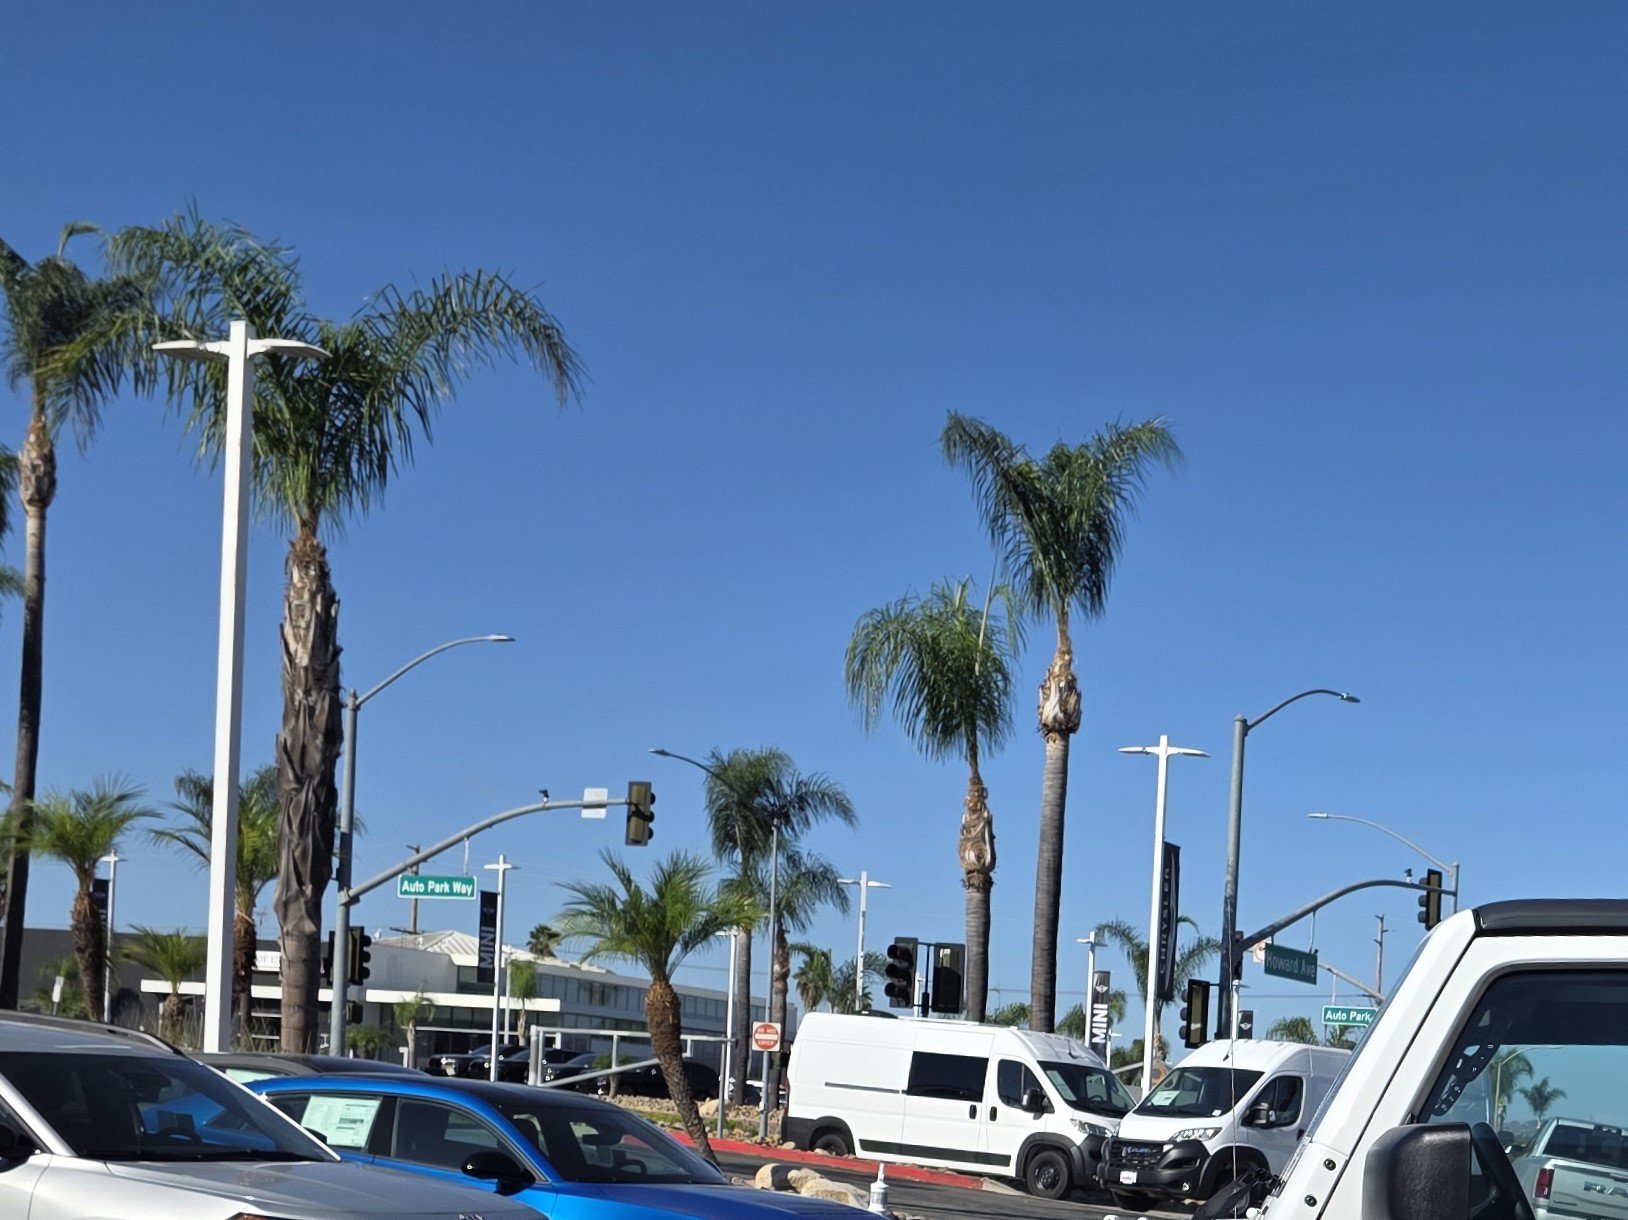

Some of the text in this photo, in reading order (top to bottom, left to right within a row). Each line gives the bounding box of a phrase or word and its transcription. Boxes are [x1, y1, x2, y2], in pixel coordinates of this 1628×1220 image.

[401, 880, 473, 896] Auto Park Way
[1159, 867, 1170, 975] CHRYSLER
[479, 927, 495, 968] MINI
[1266, 950, 1316, 978] Howard Ave
[1091, 1003, 1109, 1044] MINI
[1325, 1010, 1371, 1022] Auto Park
